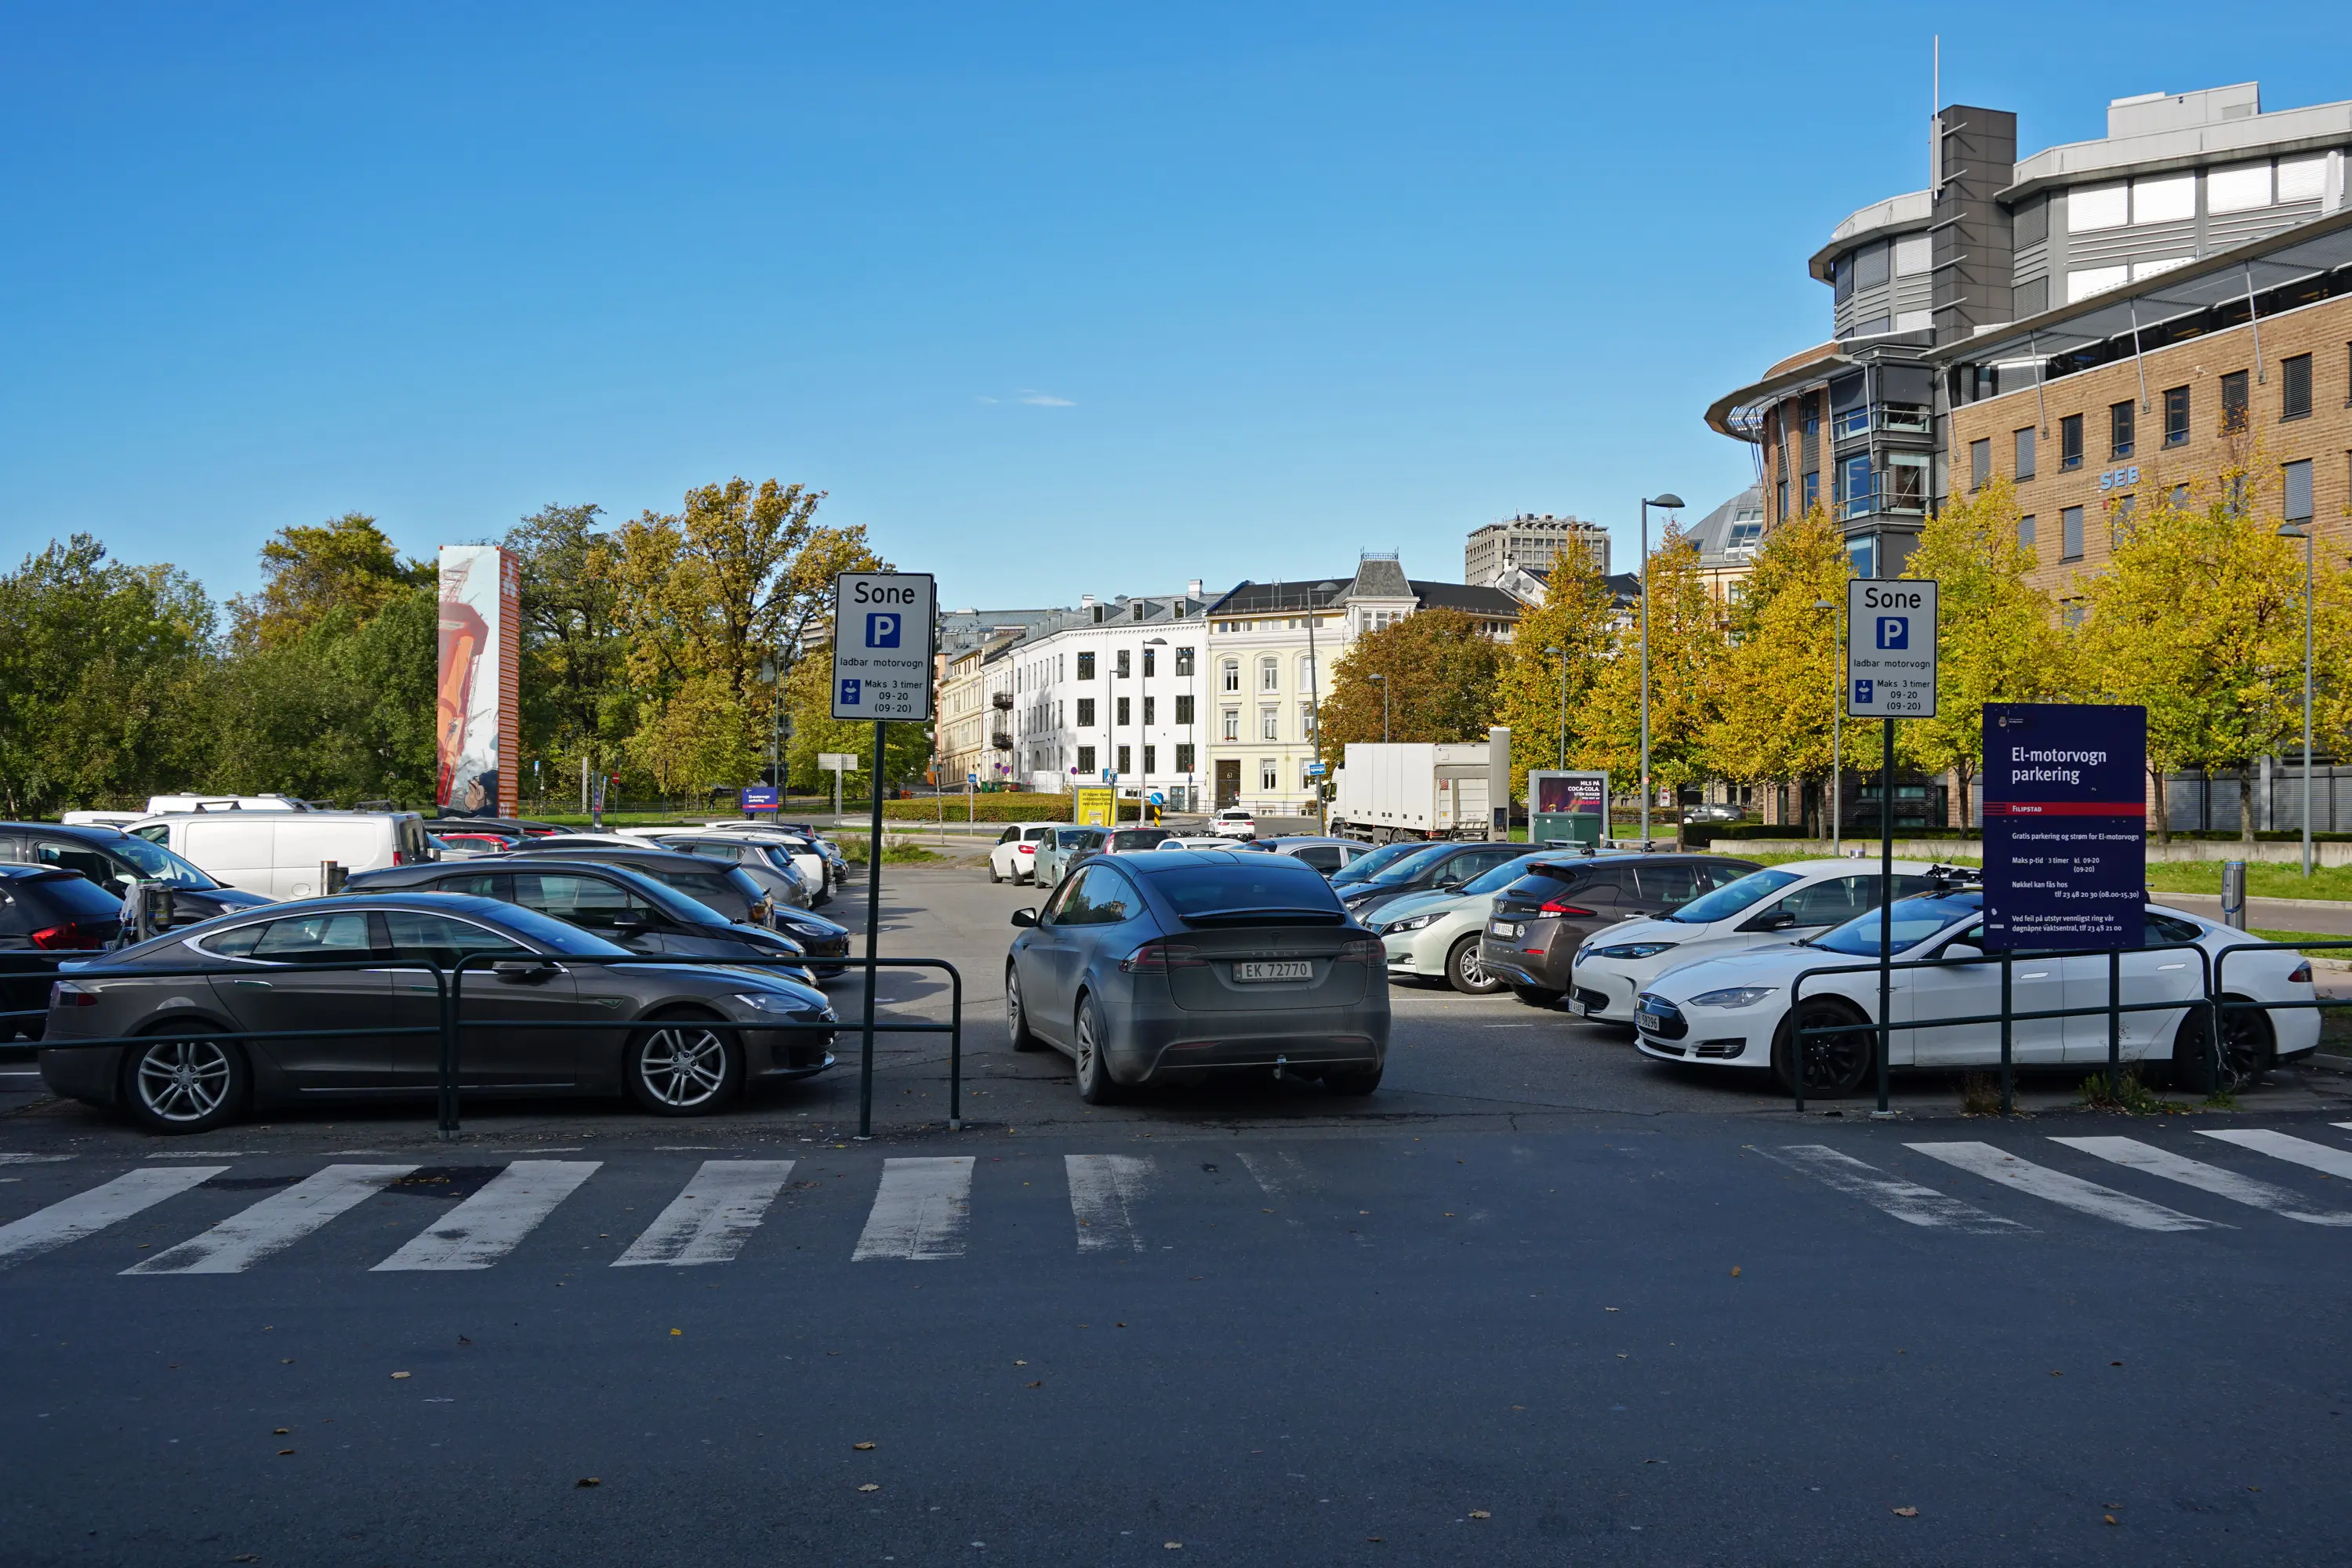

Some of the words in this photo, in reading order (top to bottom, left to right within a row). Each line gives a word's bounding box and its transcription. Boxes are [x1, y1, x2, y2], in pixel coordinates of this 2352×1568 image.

[2101, 466, 2140, 490] SEB
[854, 582, 915, 604] Sone
[1865, 587, 1921, 608] Sone
[874, 616, 895, 644] P
[1884, 619, 1903, 647] P
[873, 658, 923, 669] motorvogn
[1885, 659, 1930, 670] motorvogn
[865, 680, 887, 688] Maks
[2012, 747, 2107, 765] El-motorvogn
[2013, 767, 2080, 784] parkering
[2031, 833, 2060, 841] parkering
[1247, 964, 1262, 977] EK
[1268, 964, 1307, 976] 72770
[1642, 1013, 1657, 1029] 58296
